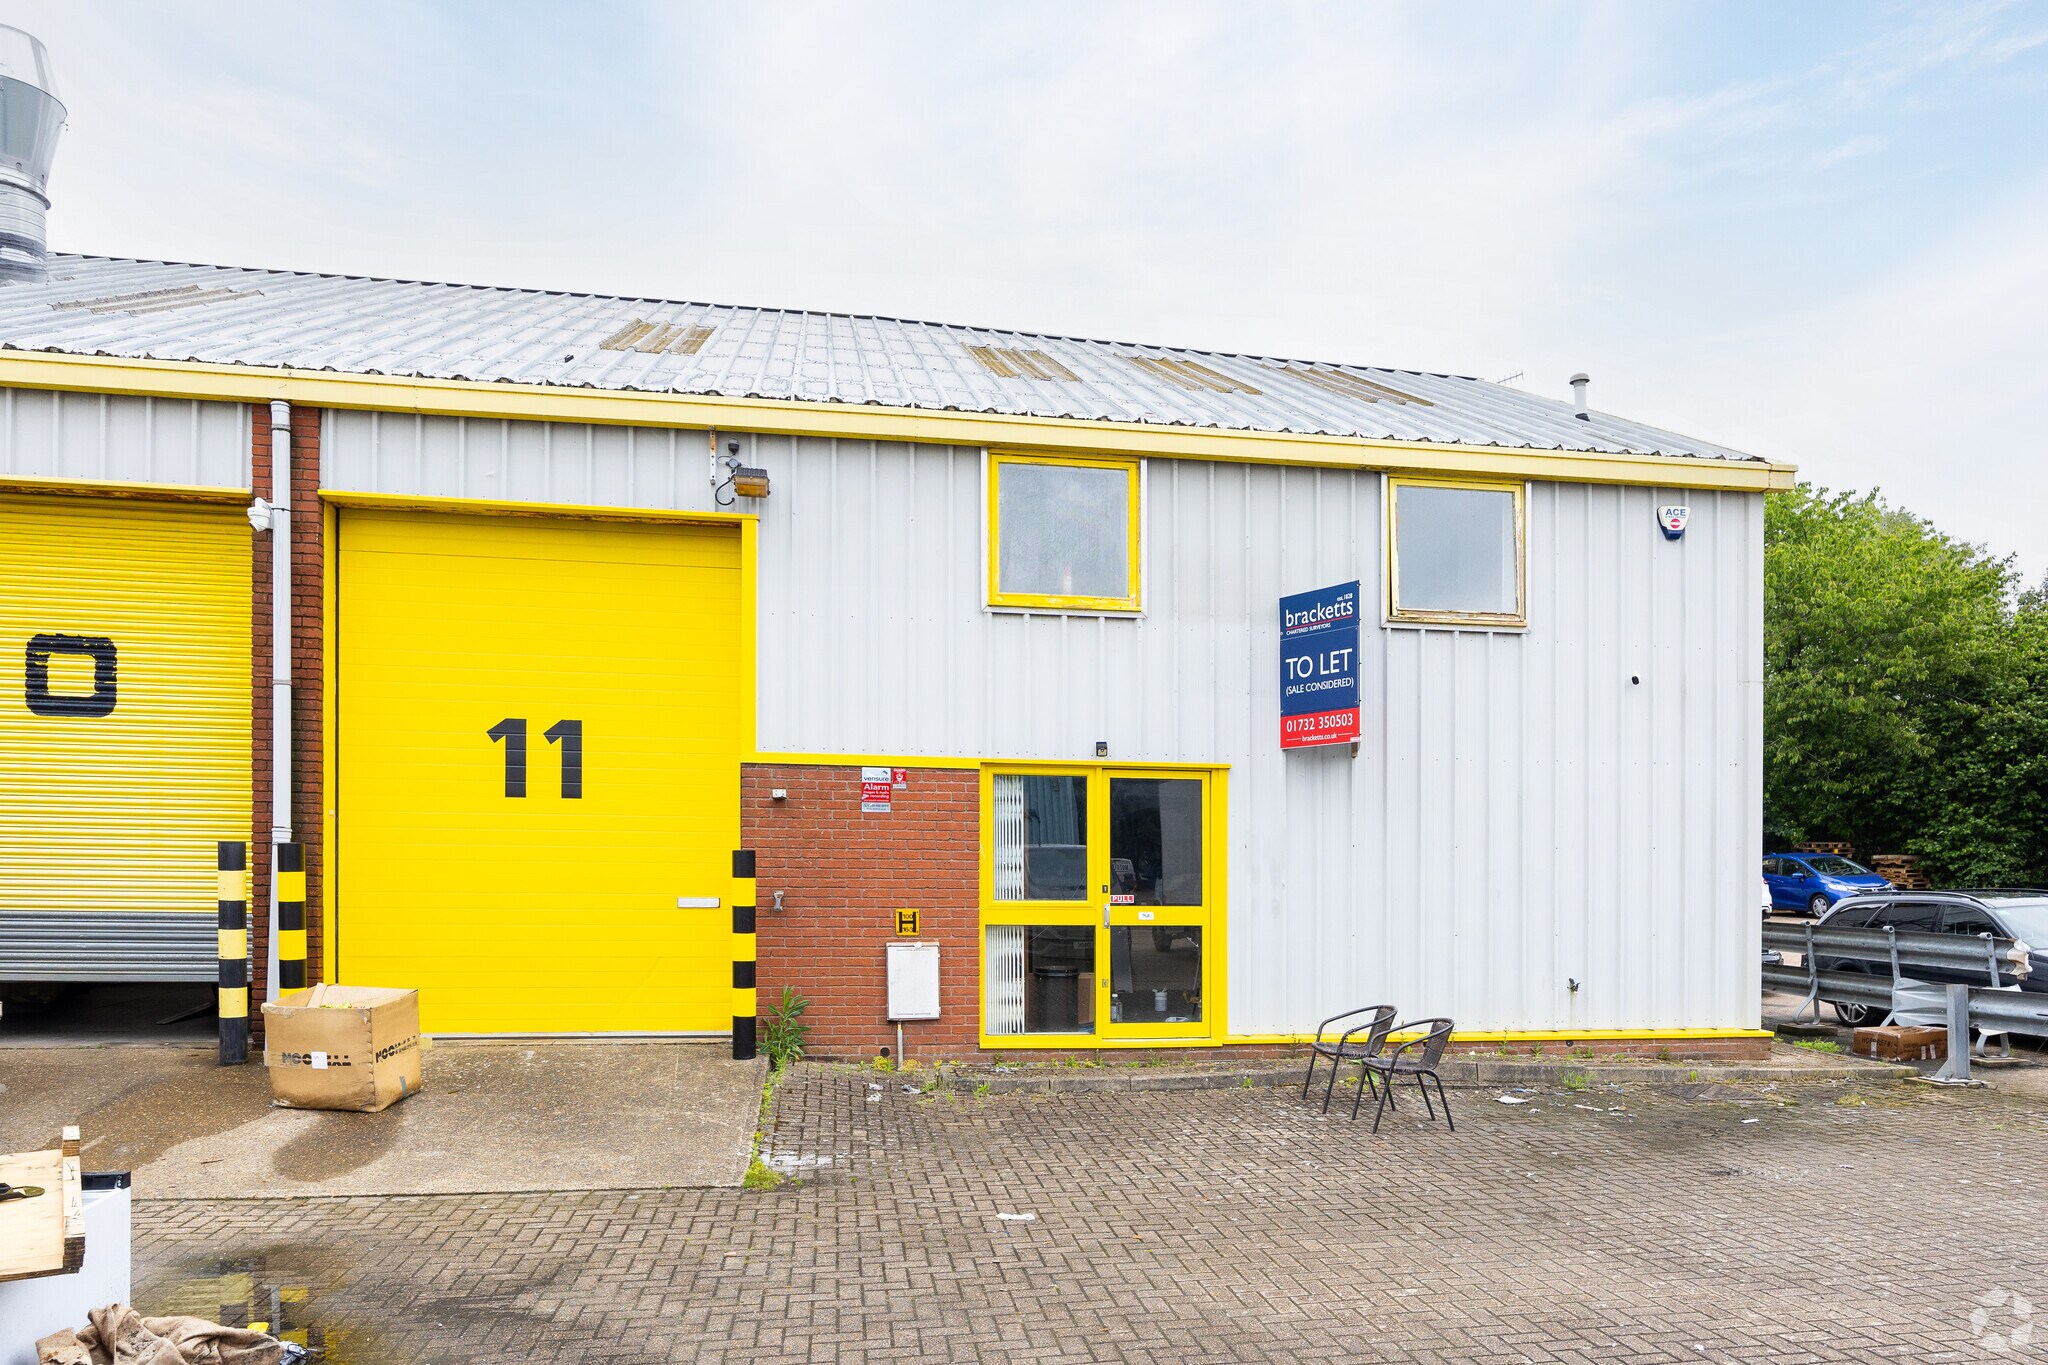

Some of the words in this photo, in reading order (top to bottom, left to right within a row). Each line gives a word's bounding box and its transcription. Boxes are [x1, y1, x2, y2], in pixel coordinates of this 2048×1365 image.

[1665, 508, 1686, 516] ACE
[1286, 601, 1353, 627] bracketts
[1286, 626, 1308, 636] CHARTERED
[1309, 622, 1331, 632] SURVEYORS
[1285, 655, 1313, 680] TO
[1320, 648, 1353, 675] LET
[1285, 684, 1304, 697] (SALE
[1305, 677, 1354, 692] CONSIDERED)
[1286, 718, 1315, 733] 01732
[1318, 713, 1353, 729] 350503
[1302, 732, 1337, 742] bracketts.co.uk
[486, 718, 582, 799] 11
[899, 912, 916, 933] H
